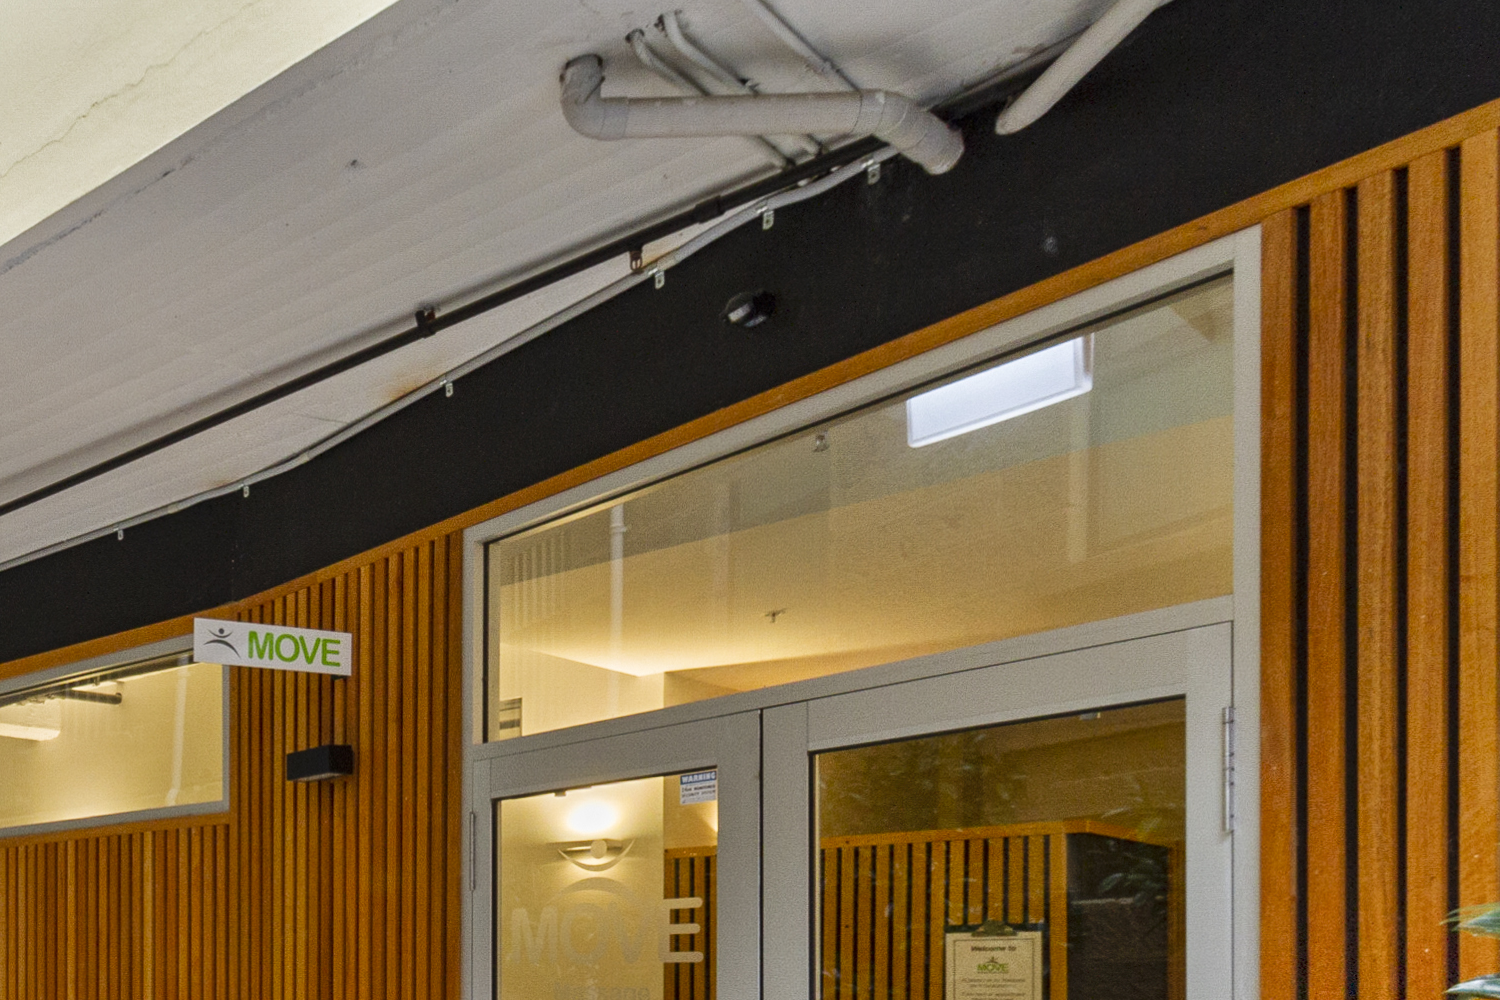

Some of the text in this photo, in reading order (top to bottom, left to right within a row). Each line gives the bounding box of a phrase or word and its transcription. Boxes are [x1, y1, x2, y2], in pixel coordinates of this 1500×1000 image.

[248, 631, 341, 667] MOVE
[681, 772, 716, 784] WARNING
[508, 897, 704, 965] MOVE
[977, 963, 1008, 972] MOVE
